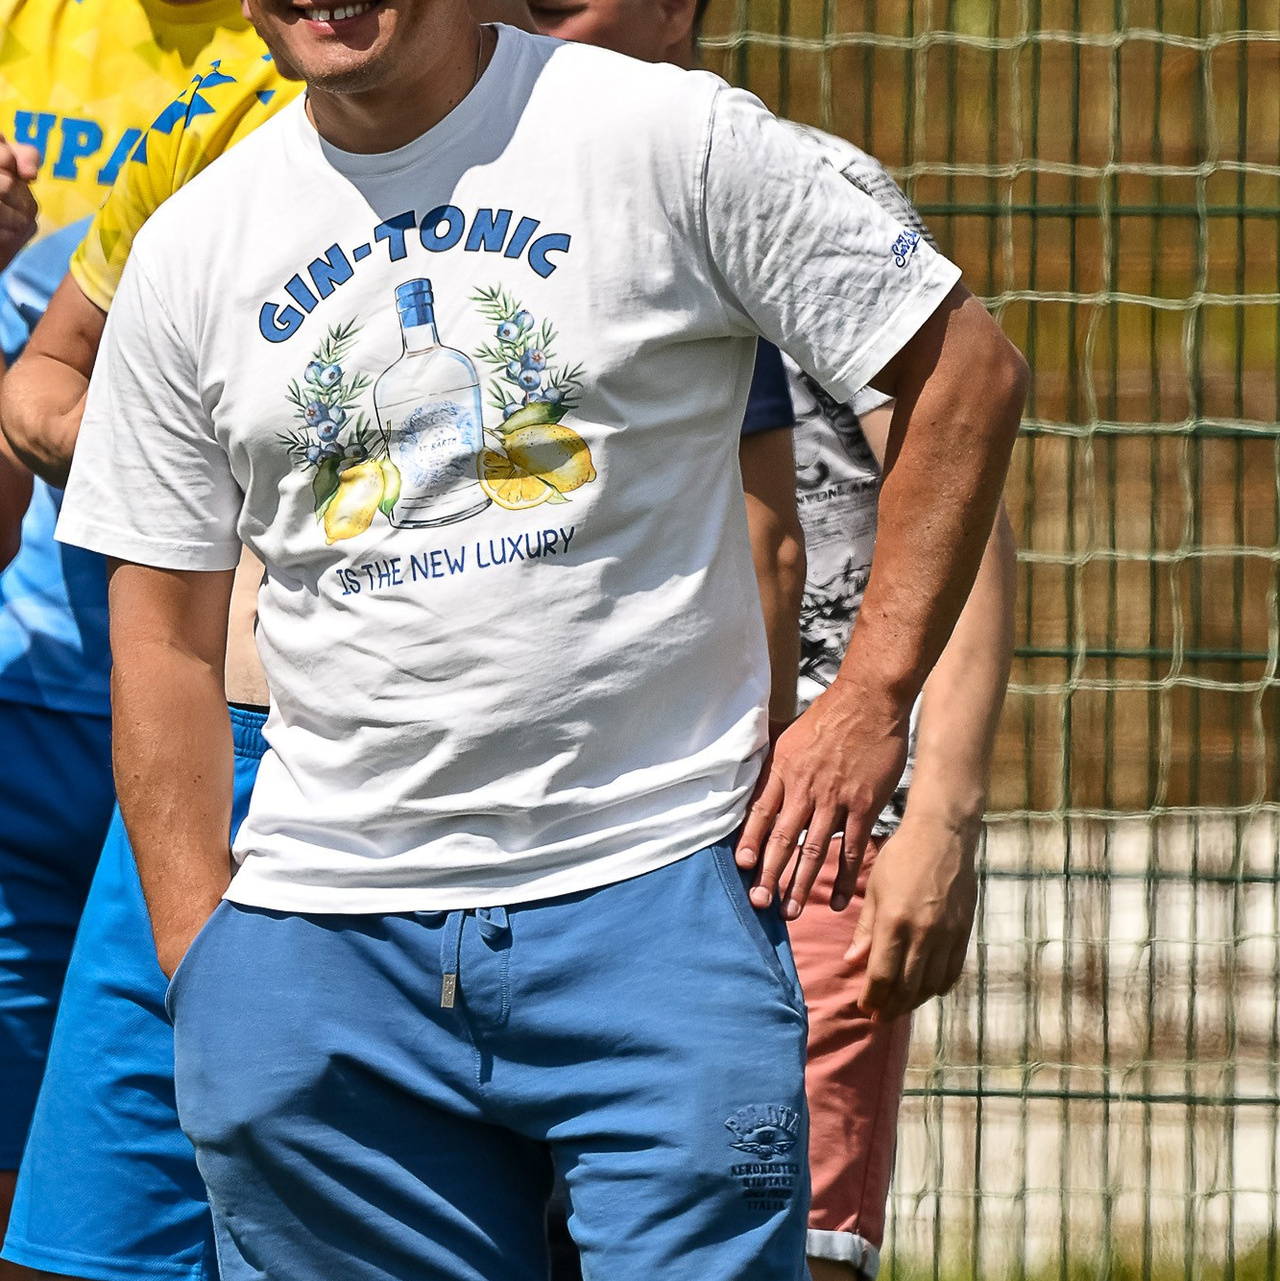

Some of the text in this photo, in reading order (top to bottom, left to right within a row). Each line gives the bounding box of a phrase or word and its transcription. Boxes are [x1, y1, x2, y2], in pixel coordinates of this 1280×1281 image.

[259, 204, 571, 344] GIN-TONIC
[336, 526, 576, 596] IS THE NEW LUXURY
